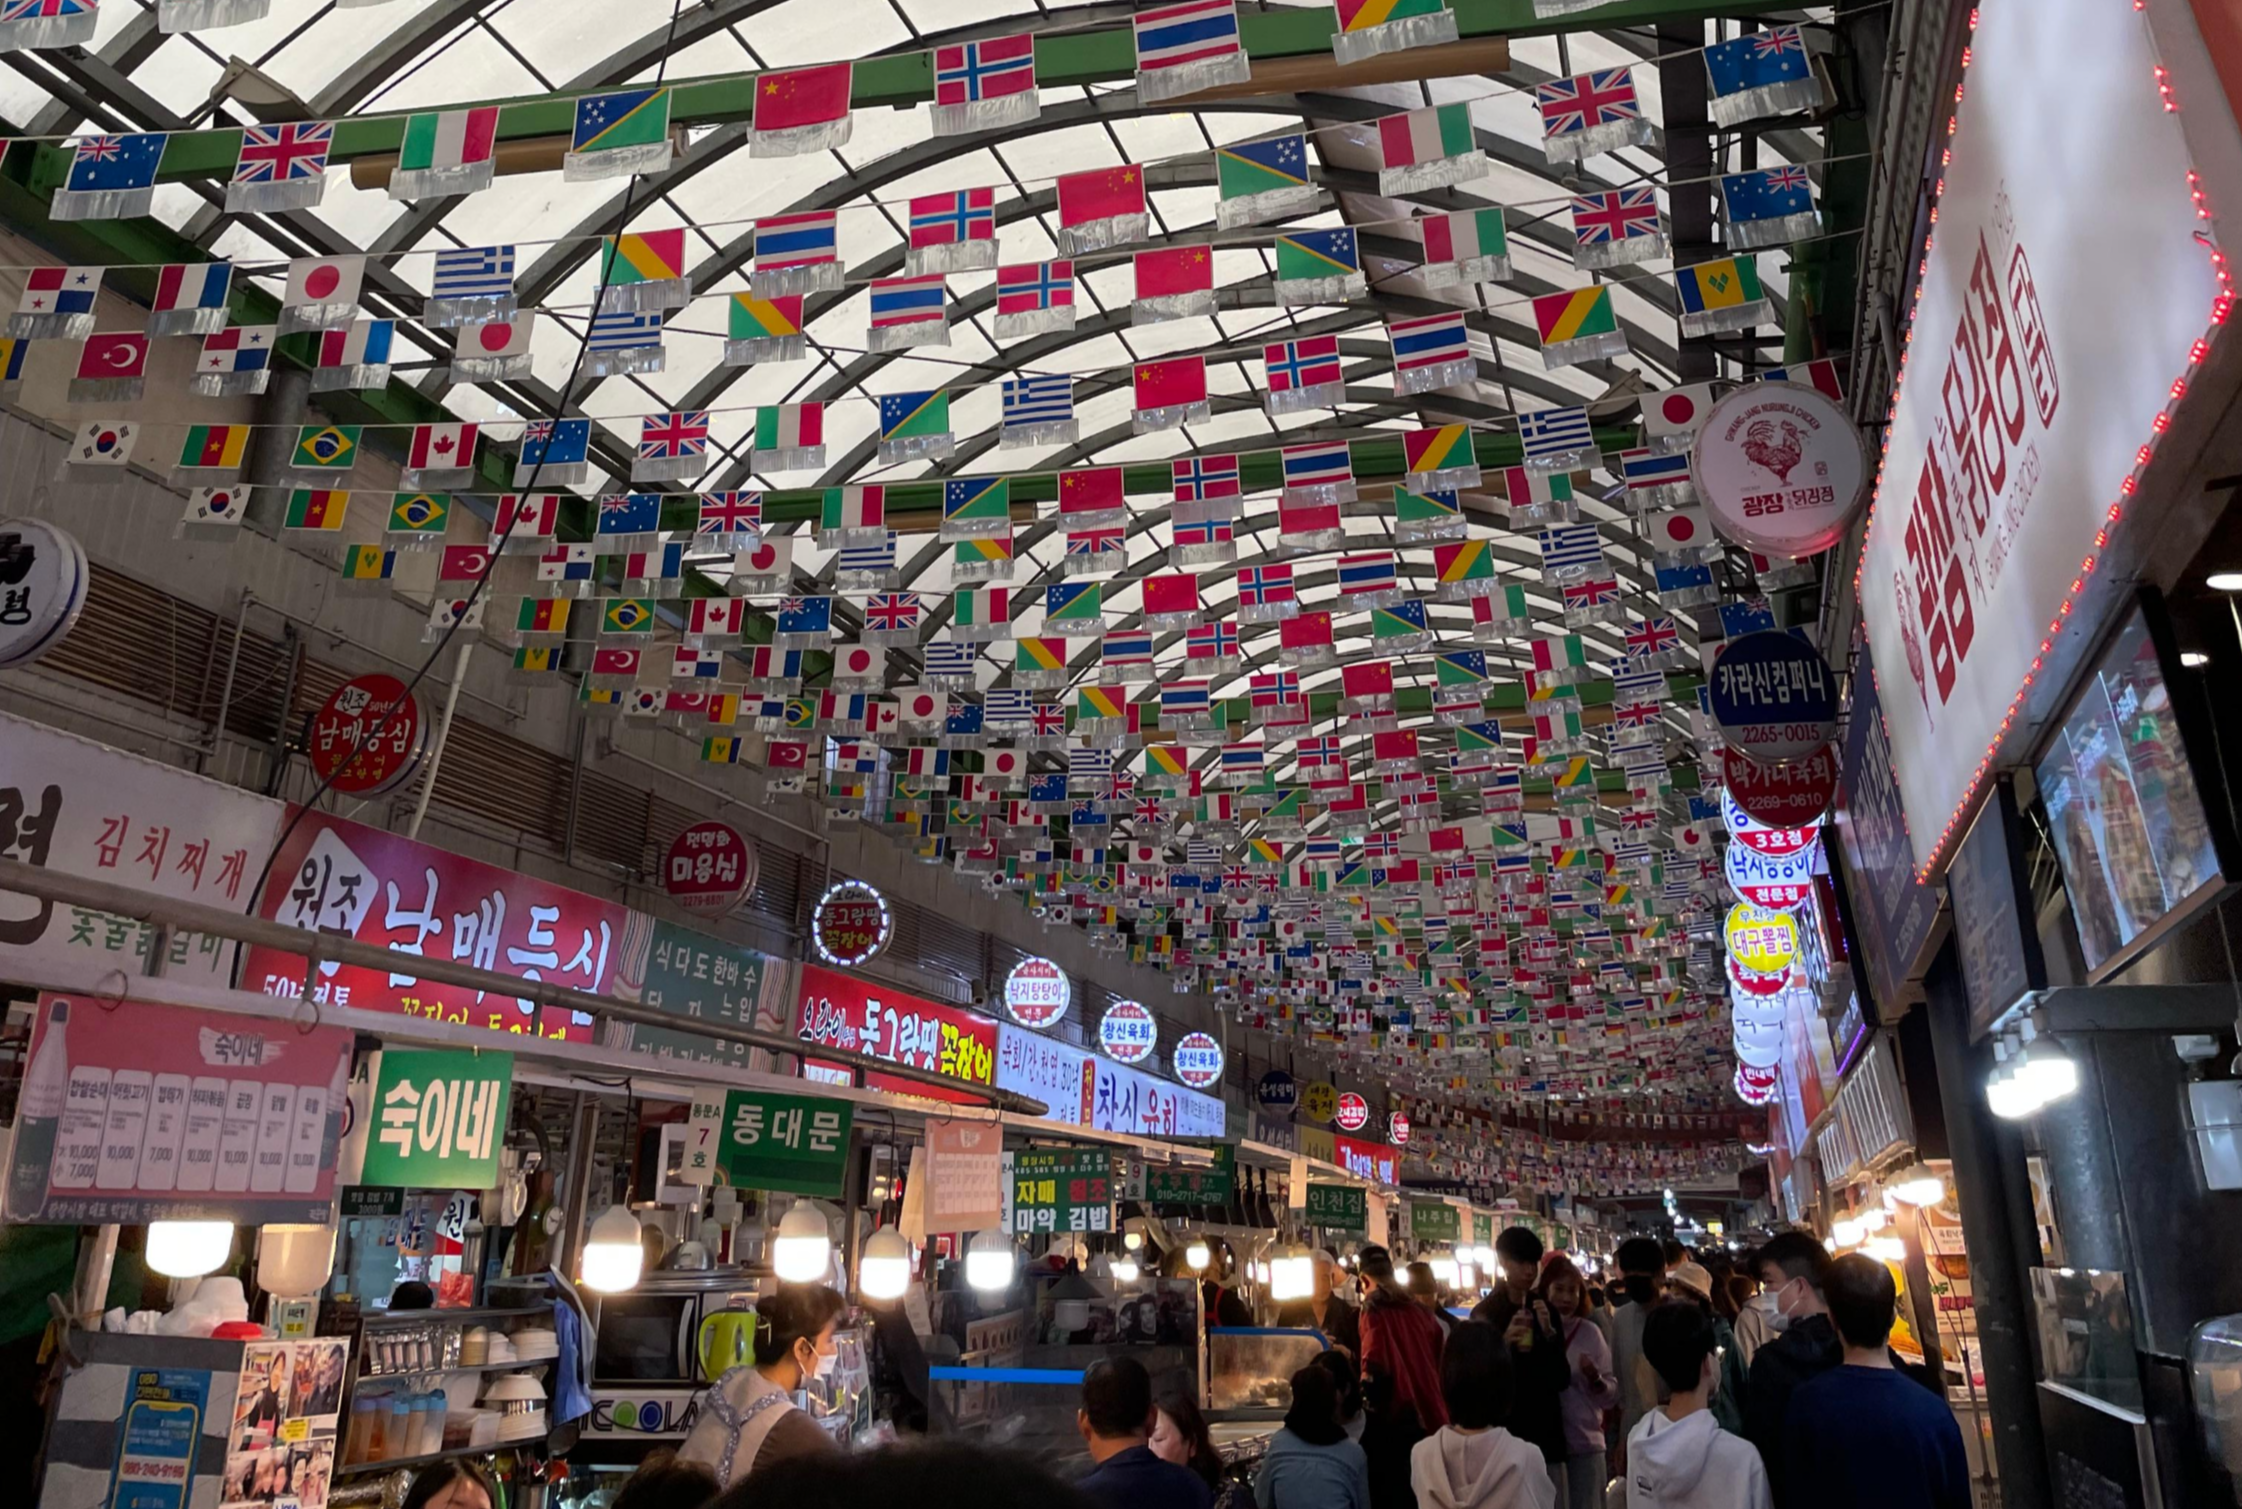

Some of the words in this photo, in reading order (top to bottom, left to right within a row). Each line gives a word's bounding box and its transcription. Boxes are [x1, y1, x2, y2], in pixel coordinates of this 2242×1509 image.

[1725, 405, 1761, 442] GWANG-JANG
[1761, 402, 1796, 415] NURUNGJI
[1795, 406, 1822, 431] CHICKEN
[1905, 436, 1975, 706] 광장
[1942, 224, 2025, 537] 닭강정
[1742, 493, 1784, 517] 광장
[1792, 486, 1835, 506] 닭강정
[1719, 659, 1826, 706] 카라신컴퍼니
[340, 690, 365, 711] 원조
[320, 717, 411, 753] 남매등심
[1743, 724, 1820, 743] 2265-0015
[1748, 793, 1823, 810] 2269-0610
[1755, 830, 1803, 848] 3호점
[94, 815, 248, 900] 김치찌개
[672, 853, 738, 884] 미용실
[823, 907, 880, 927] 동그랑땡
[385, 867, 612, 1027] 남매등심
[826, 930, 874, 950] 꼼장어
[1733, 926, 1792, 956] 대구뽈찜
[1010, 981, 1061, 1001] 낙지탕탕이
[859, 998, 940, 1072] 동그랑땡
[940, 1022, 993, 1086] 꼼장어
[1104, 1022, 1150, 1041] 창신육회
[215, 1033, 264, 1066] 숙이네
[1178, 1051, 1219, 1069] 창신육회
[379, 1079, 501, 1159] 숙이네
[693, 1104, 721, 1119] 동문A
[699, 1128, 710, 1146] 7
[732, 1103, 842, 1152] 동대문
[69, 1145, 99, 1159] 10,000
[150, 1147, 173, 1163] 7,000
[691, 1151, 707, 1168] 호
[69, 1164, 96, 1180] 7,000
[1132, 1164, 1141, 1179] 9
[1017, 1179, 1056, 1204] 자매
[1309, 1189, 1363, 1214] 인천집
[1016, 1208, 1057, 1232] 마약
[1068, 1206, 1109, 1230] 김밥
[1416, 1209, 1454, 1224] 나주집
